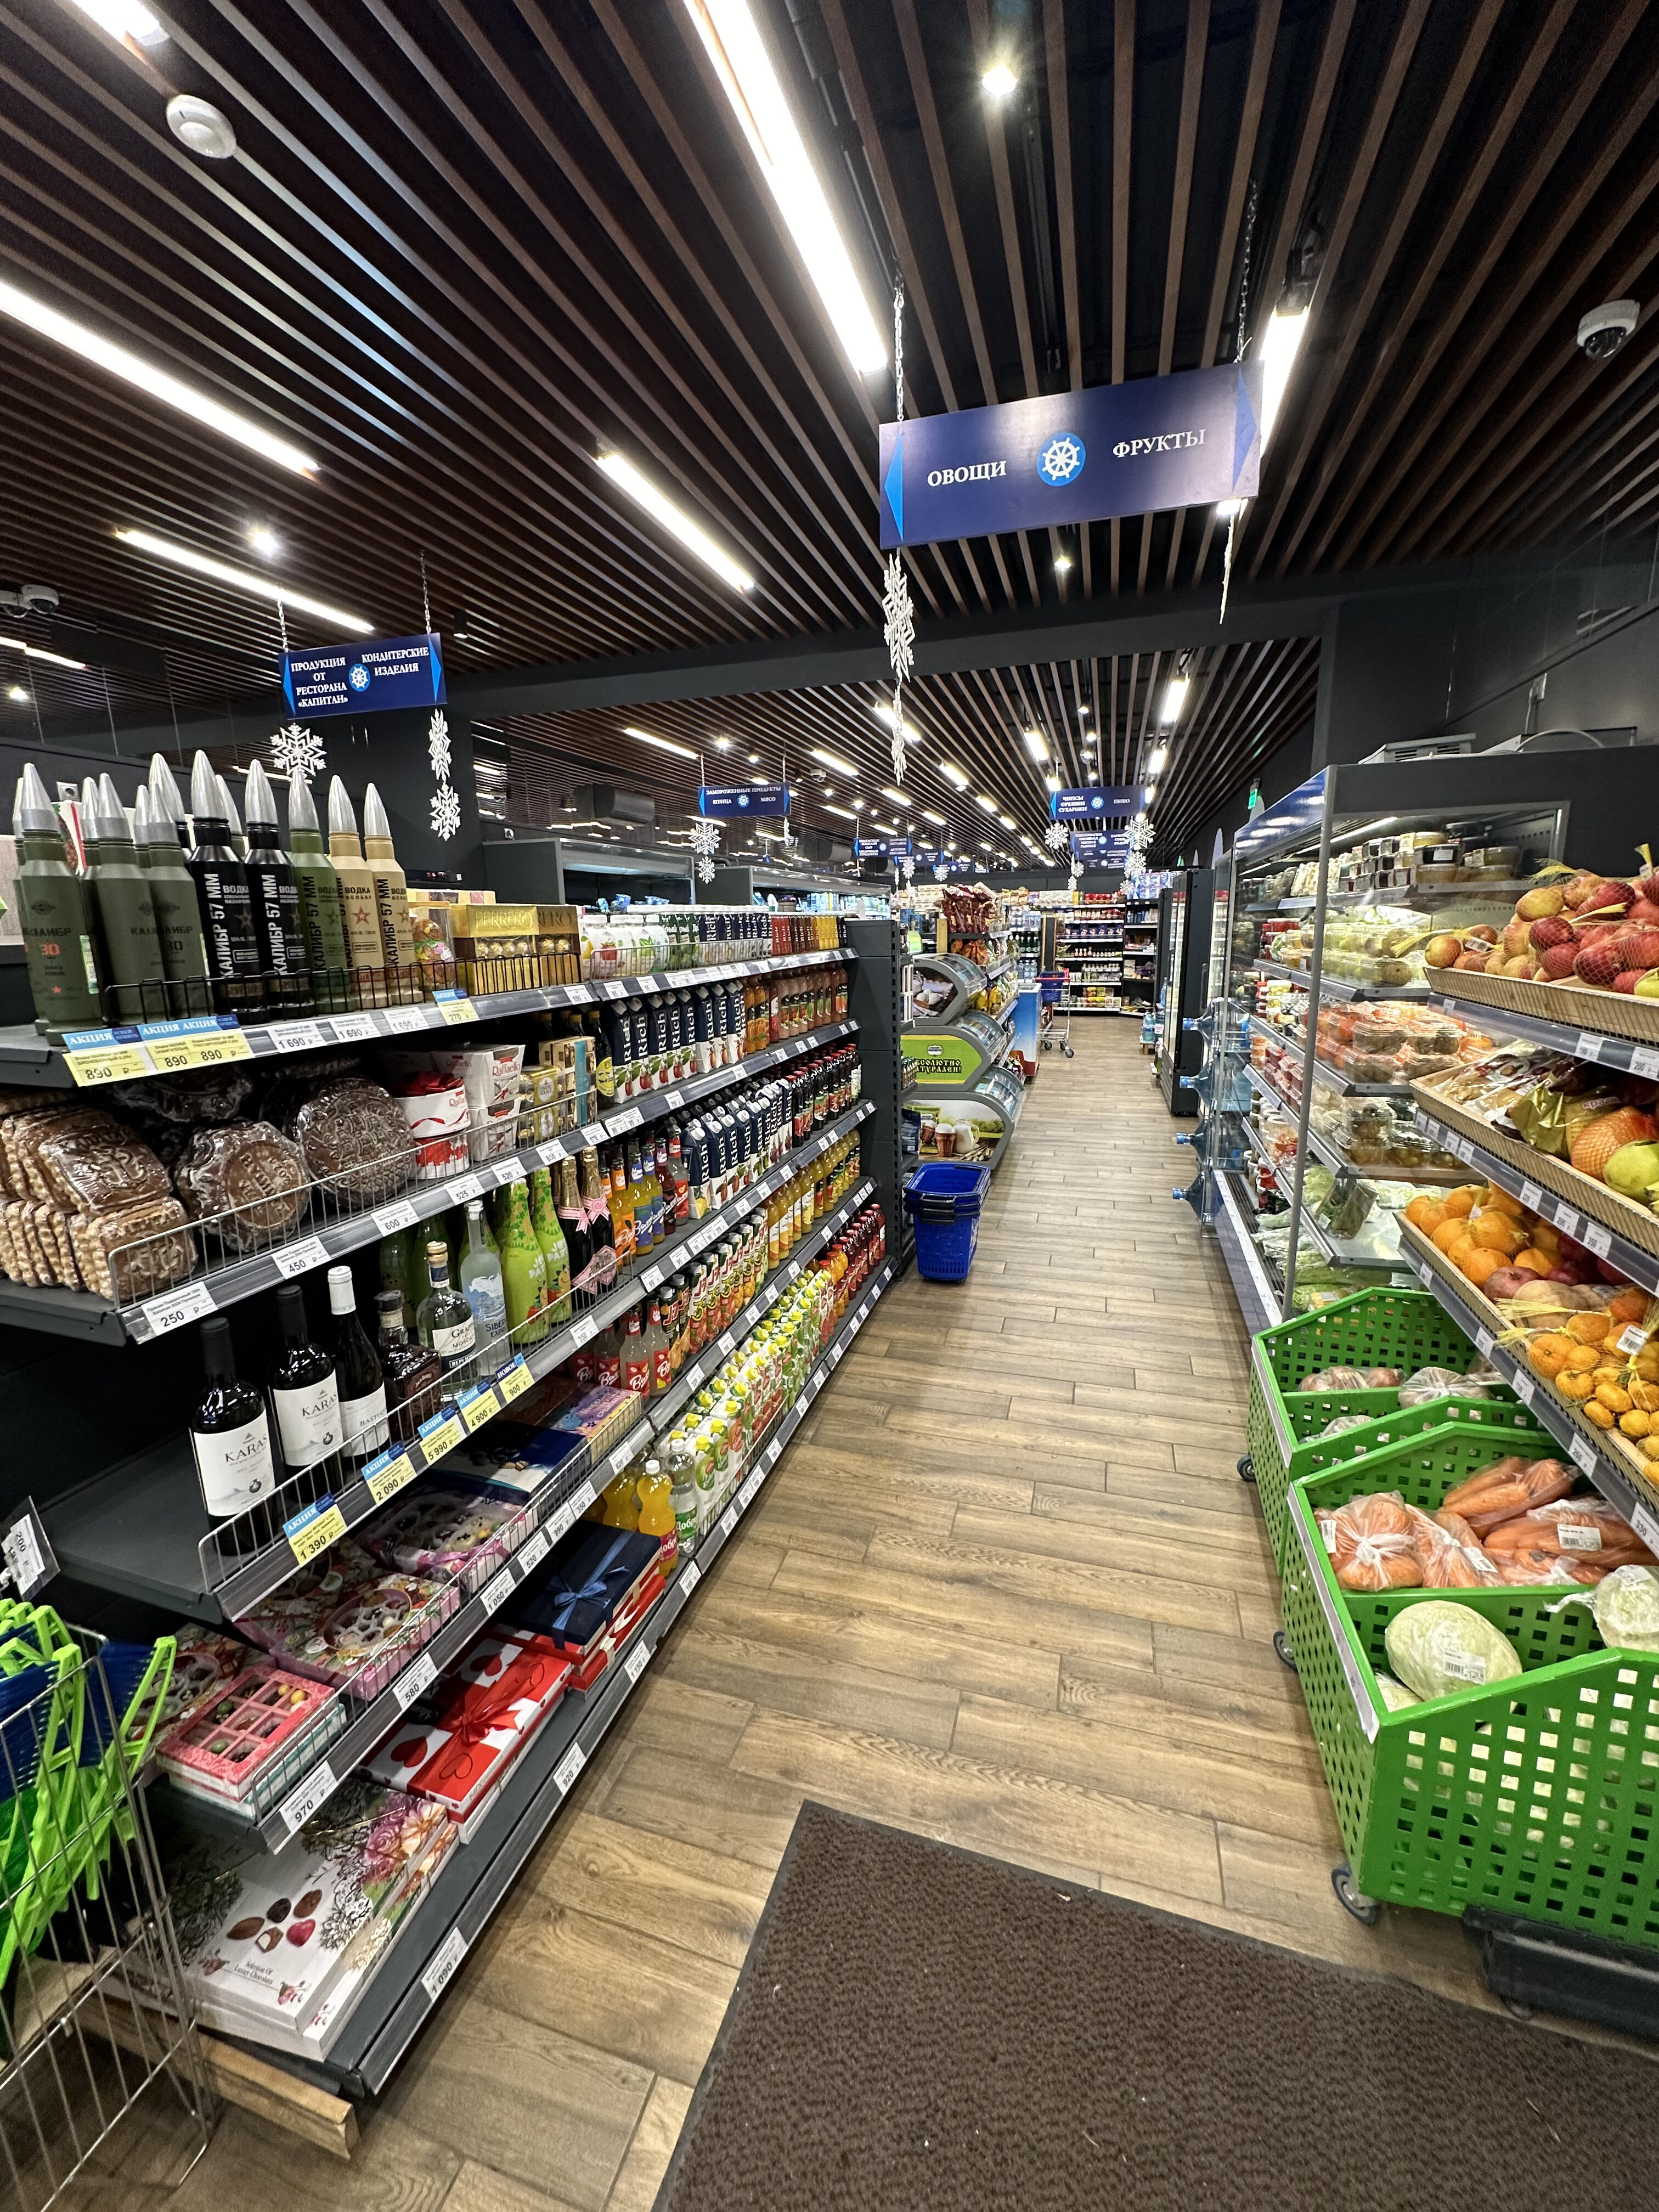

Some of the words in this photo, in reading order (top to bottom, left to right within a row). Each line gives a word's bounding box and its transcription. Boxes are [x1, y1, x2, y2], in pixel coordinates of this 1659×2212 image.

[1112, 429, 1206, 458] ФРУКТЫ
[927, 460, 1007, 487] ОВОЩИ
[362, 646, 429, 663] КОНДИТЕРСКИЕ
[291, 657, 346, 672] ПРОДУКЦИЯ
[374, 663, 419, 676] ИЗДЕЛИЯ
[313, 672, 325, 681] ОТ
[296, 682, 347, 695] РЕСТОРАНА
[298, 695, 348, 707] «КАПИТАН»
[204, 873, 222, 898] ММ
[261, 874, 278, 898] ММ
[302, 876, 317, 898] ММ
[345, 887, 370, 895] ВОДКА
[377, 878, 390, 899] ММ
[208, 903, 225, 919] 57
[265, 902, 281, 918] 57
[306, 902, 319, 917] 57
[380, 902, 392, 916] 57
[475, 911, 533, 929] FERRERO
[705, 916, 716, 941] Rich
[268, 922, 287, 975] КАЛИБР
[308, 922, 326, 970] КАЛИБР
[382, 920, 399, 964] КАЛИБР
[212, 924, 234, 978] КАЛИБР
[706, 1003, 714, 1038] Rich
[719, 996, 727, 1035] Rich
[143, 1023, 179, 1035] АКЦИЯ
[183, 1019, 217, 1030] АКЦИЯ
[347, 1028, 363, 1037] 690
[658, 1013, 667, 1052] Rich
[672, 1009, 680, 1048] Rich
[687, 1006, 696, 1043] Rich
[70, 1032, 113, 1045] АКЦИЯ
[287, 1038, 305, 1047] 690
[636, 1016, 648, 1057] Rich
[165, 1056, 188, 1068] 890
[201, 1049, 222, 1061] 890
[86, 1068, 112, 1080] 890
[492, 1062, 521, 1076] Raffaello
[916, 1065, 962, 1074] АТУРАЛЕН!
[546, 1153, 556, 1161] 850
[699, 1144, 709, 1181] Rich
[456, 1190, 469, 1200] 525
[385, 1219, 399, 1230] 600
[1588, 1237, 1596, 1248] 350
[289, 1260, 306, 1272] 450
[161, 1311, 184, 1328] 250
[496, 1361, 516, 1380] НОВОЕ
[460, 1390, 478, 1406] АКЦИЯ
[509, 1384, 521, 1396] 900
[302, 1392, 337, 1417] KARAS
[476, 1410, 488, 1421] 900
[421, 1414, 443, 1434] АКЦИЯ
[225, 1433, 267, 1463] KARAS
[428, 1452, 433, 1460] 5
[434, 1442, 448, 1456] 990
[1573, 1448, 1582, 1462] 260
[365, 1453, 390, 1475] АКЦИЯ
[376, 1492, 383, 1500] 2
[383, 1479, 398, 1494] 090
[577, 1502, 586, 1513] 350
[287, 1506, 317, 1533] АКЦИЯ
[554, 1525, 563, 1536] 990
[1635, 1520, 1647, 1536] 330
[16, 1532, 26, 1552] 200
[301, 1549, 307, 1560] 1
[309, 1535, 326, 1554] 390
[527, 1555, 537, 1569] 520
[493, 1592, 504, 1606] 050
[295, 1799, 314, 1823] 970
[432, 1984, 437, 1993] 1
[438, 1962, 452, 1984] 090
